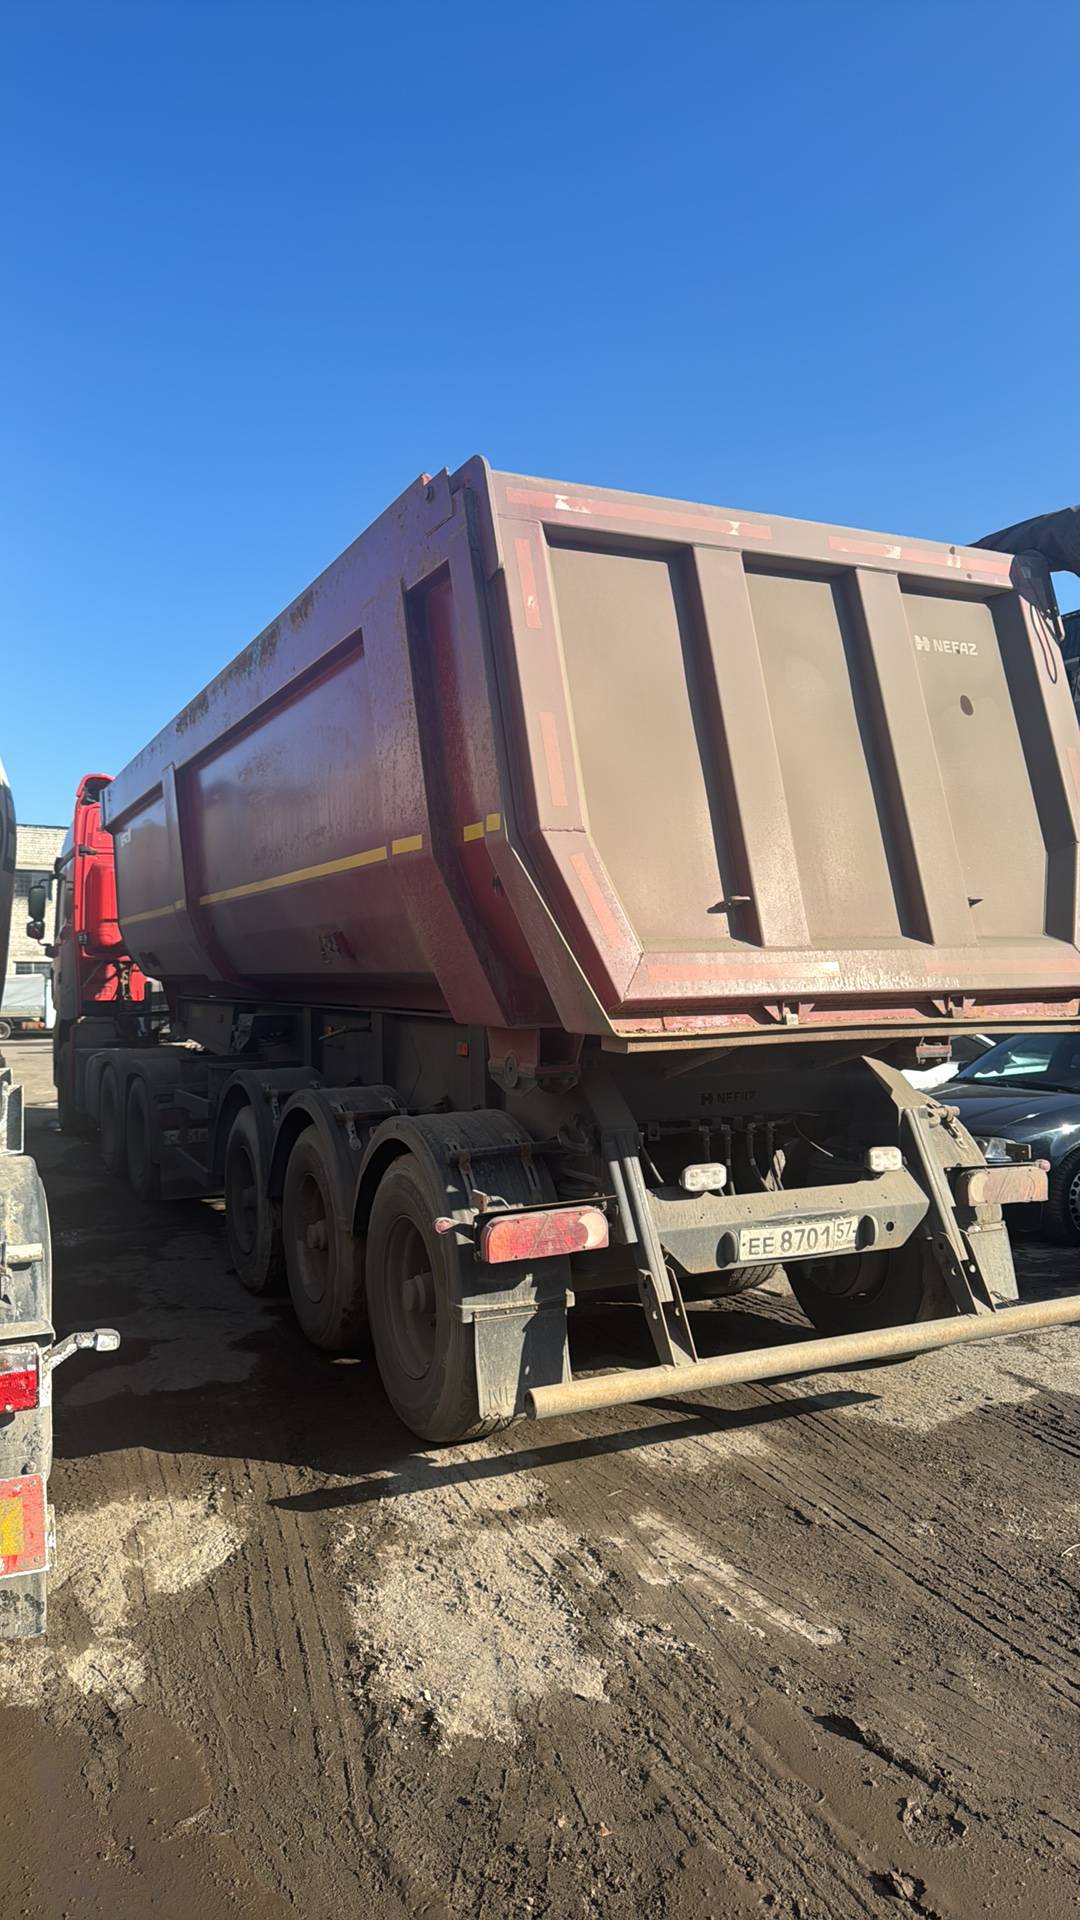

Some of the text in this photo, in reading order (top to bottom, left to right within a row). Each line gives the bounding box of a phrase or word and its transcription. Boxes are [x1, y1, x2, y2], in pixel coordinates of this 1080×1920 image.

[932, 639, 979, 656] NEFAZ
[748, 1237, 774, 1255] EE
[780, 1226, 831, 1252] 8701
[836, 1221, 853, 1239] 57
